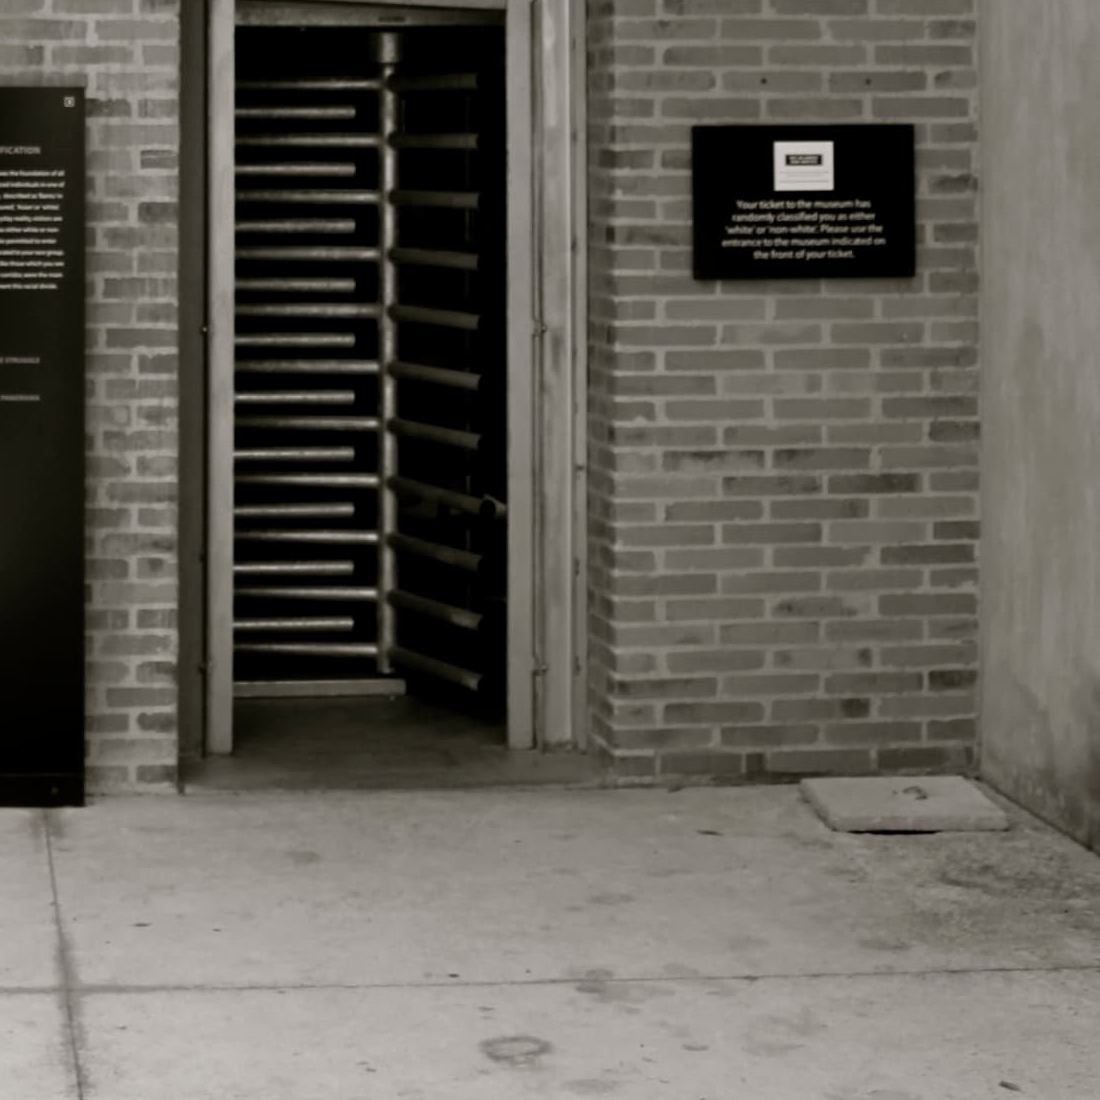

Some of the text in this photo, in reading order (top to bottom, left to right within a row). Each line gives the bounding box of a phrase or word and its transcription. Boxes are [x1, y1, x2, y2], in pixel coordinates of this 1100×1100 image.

[736, 199, 872, 209] Your ticket to the museum has
[731, 212, 876, 224] randomly classified you as either
[756, 227, 767, 235] or
[820, 224, 849, 234] Please
[851, 226, 867, 234] use
[868, 224, 884, 234] the
[721, 236, 887, 248] entrance to the museum indicated on
[753, 250, 770, 260] the
[771, 250, 794, 260] front
[795, 250, 805, 260] of
[806, 251, 827, 261] your
